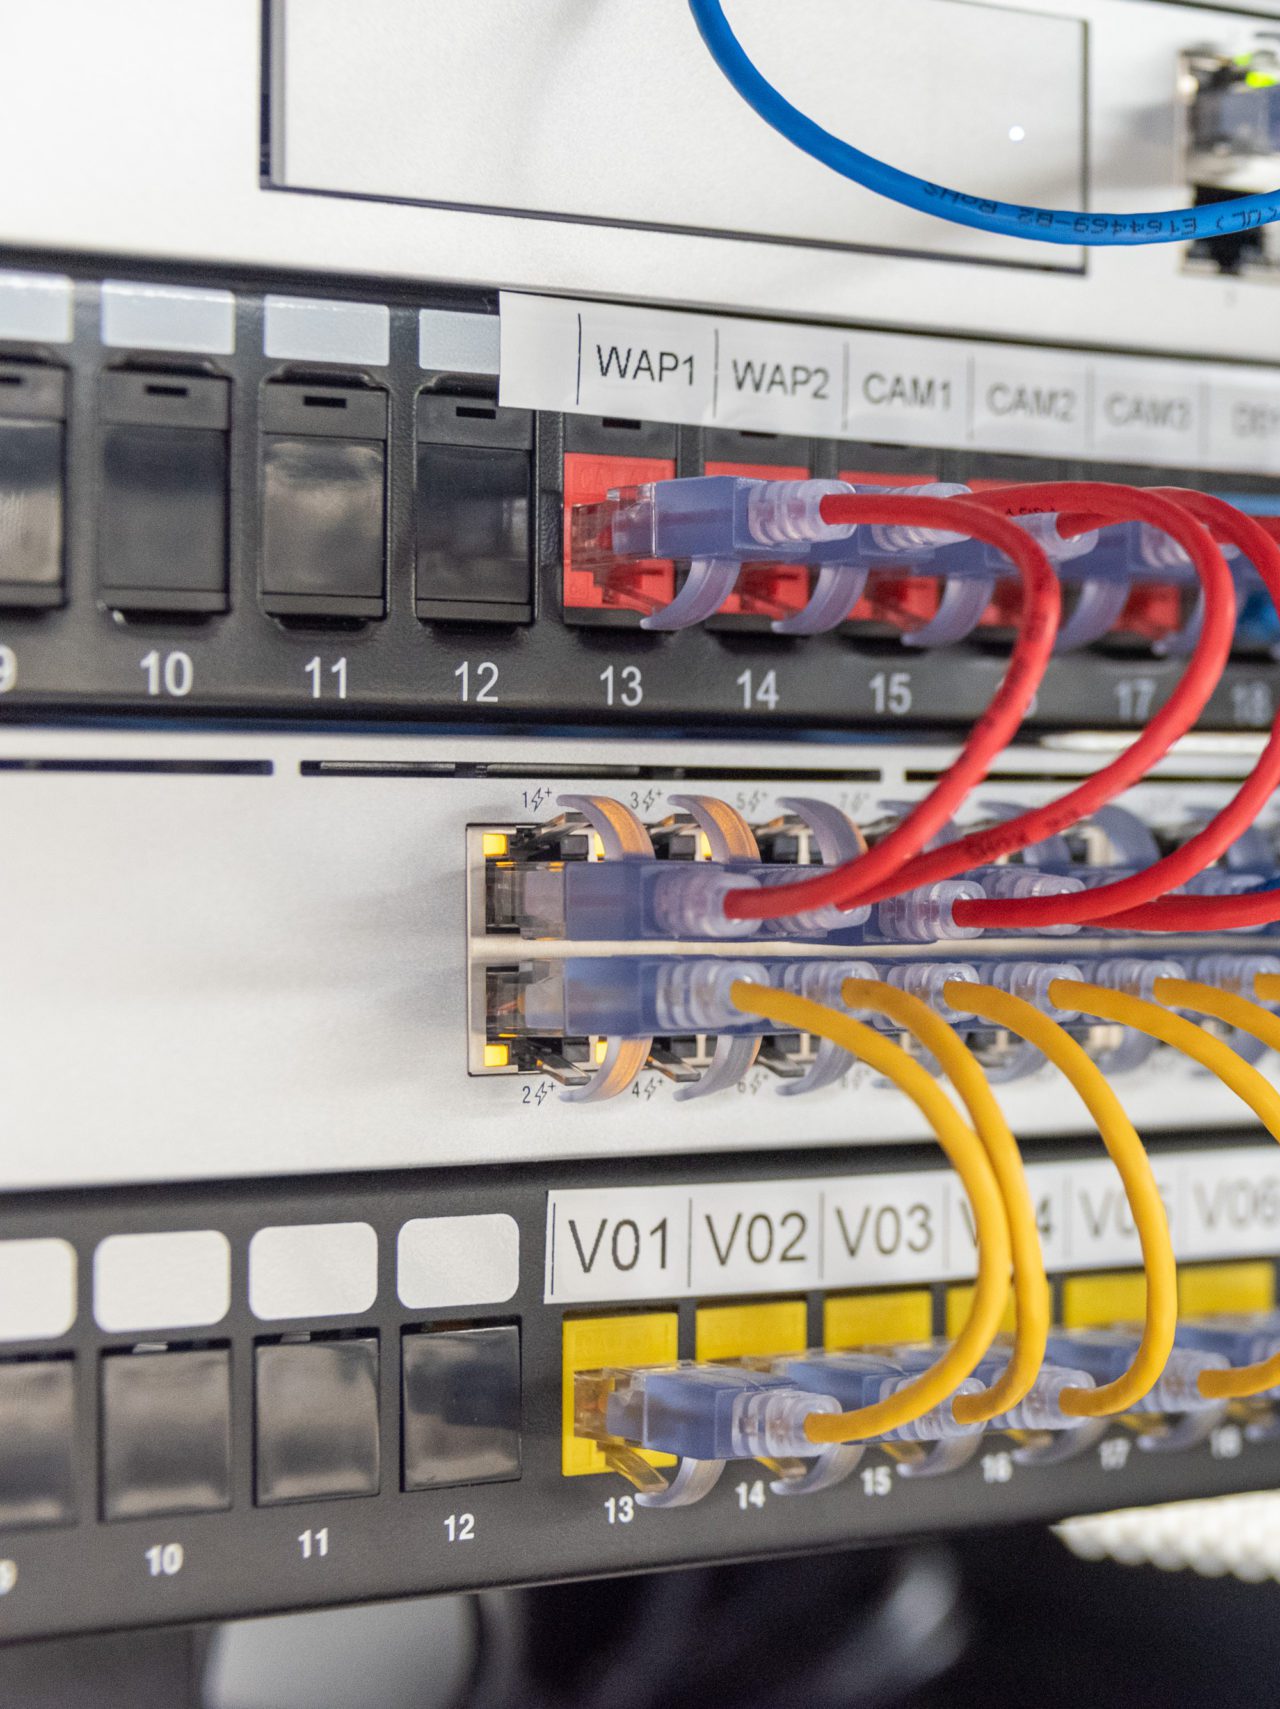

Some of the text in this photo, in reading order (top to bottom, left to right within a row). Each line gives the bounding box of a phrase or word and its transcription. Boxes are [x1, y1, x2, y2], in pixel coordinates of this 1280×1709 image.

[595, 343, 696, 388] WAP1
[731, 359, 830, 402] WAP2
[862, 373, 954, 411] CAM1
[986, 384, 1077, 424] CAM2
[140, 650, 194, 697] 10
[304, 656, 348, 700] 11
[455, 661, 499, 703] 12
[600, 665, 643, 707] 13
[736, 668, 780, 711] 14
[868, 672, 912, 714] 15
[1114, 677, 1156, 721] 17
[568, 1216, 669, 1274] V01
[704, 1210, 808, 1267] V02
[834, 1203, 934, 1260] V03
[735, 1480, 765, 1510] 14
[861, 1467, 892, 1497] 15
[443, 1513, 476, 1542] 12
[604, 1496, 635, 1525] 13
[145, 1543, 184, 1577] 10
[298, 1527, 329, 1559] 11
